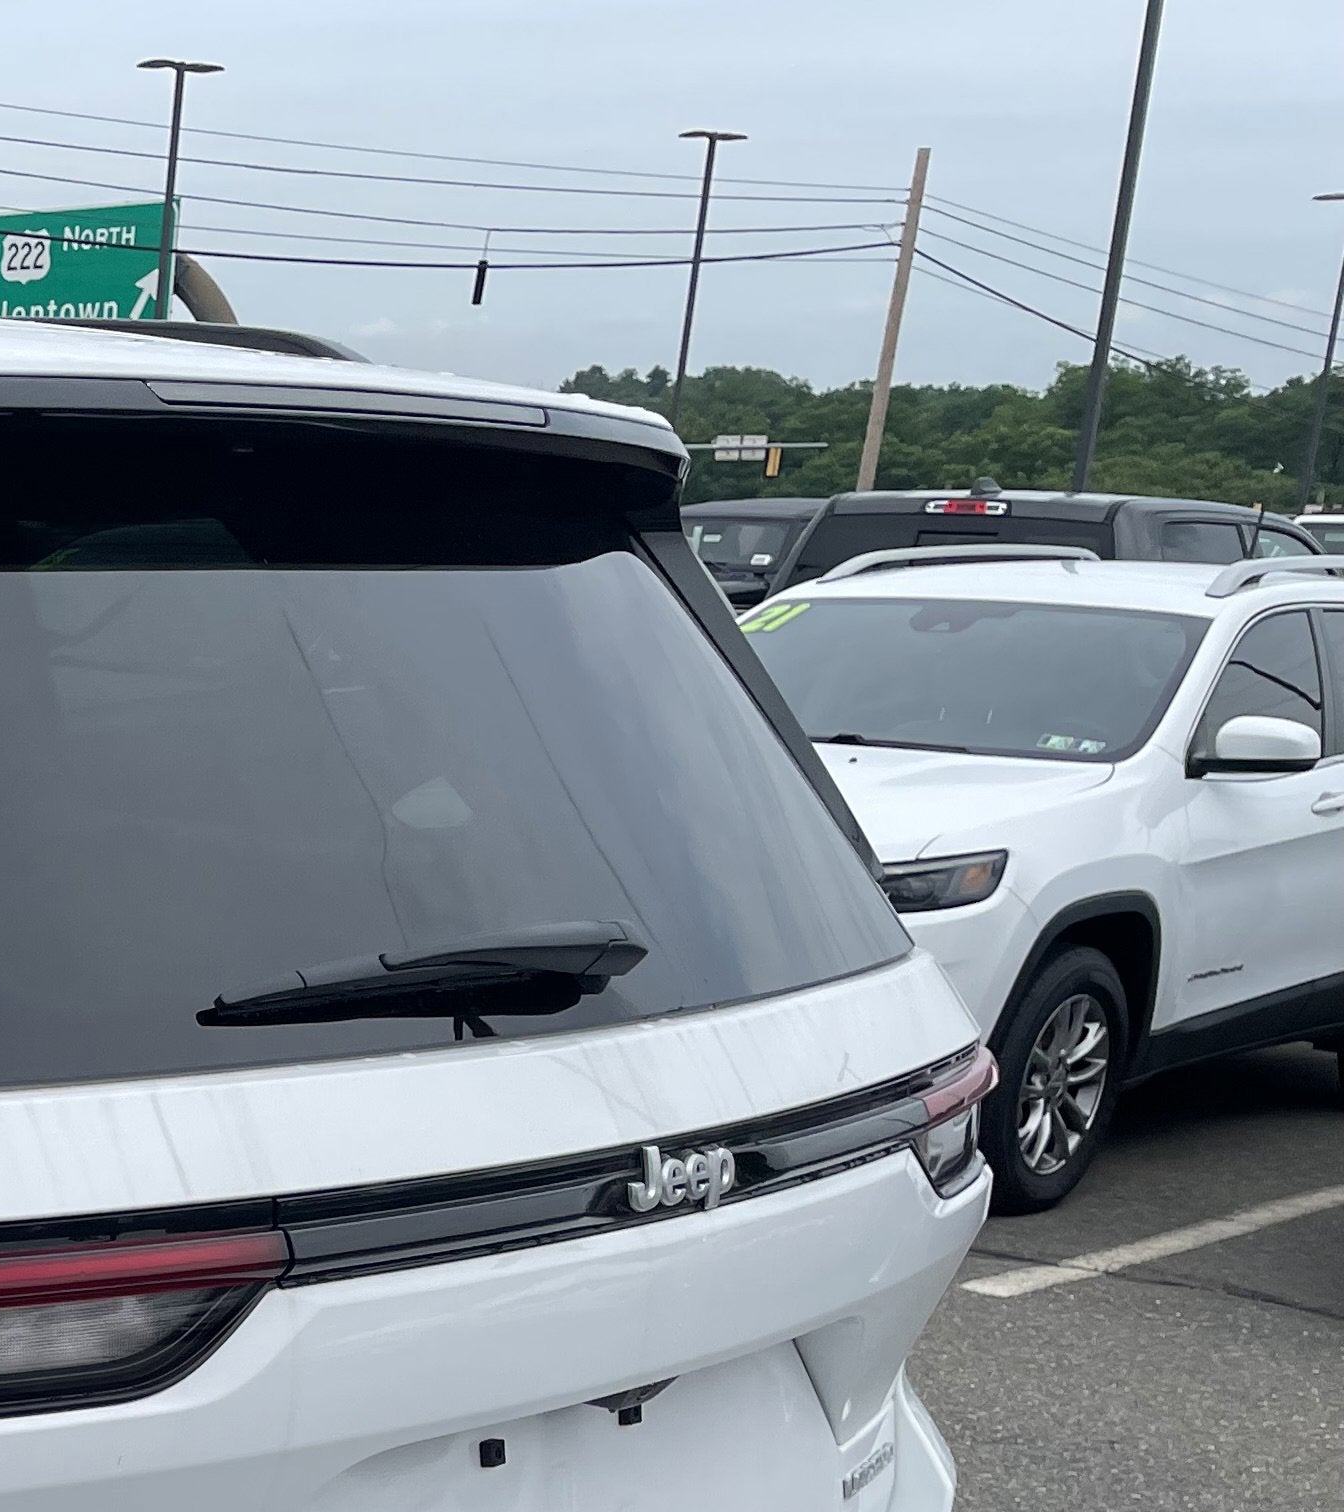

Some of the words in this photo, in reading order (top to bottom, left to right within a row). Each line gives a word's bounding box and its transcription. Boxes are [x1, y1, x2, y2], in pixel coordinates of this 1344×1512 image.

[7, 241, 45, 271] 222
[62, 225, 136, 251] NORTH
[627, 1145, 736, 1213] Jeep
